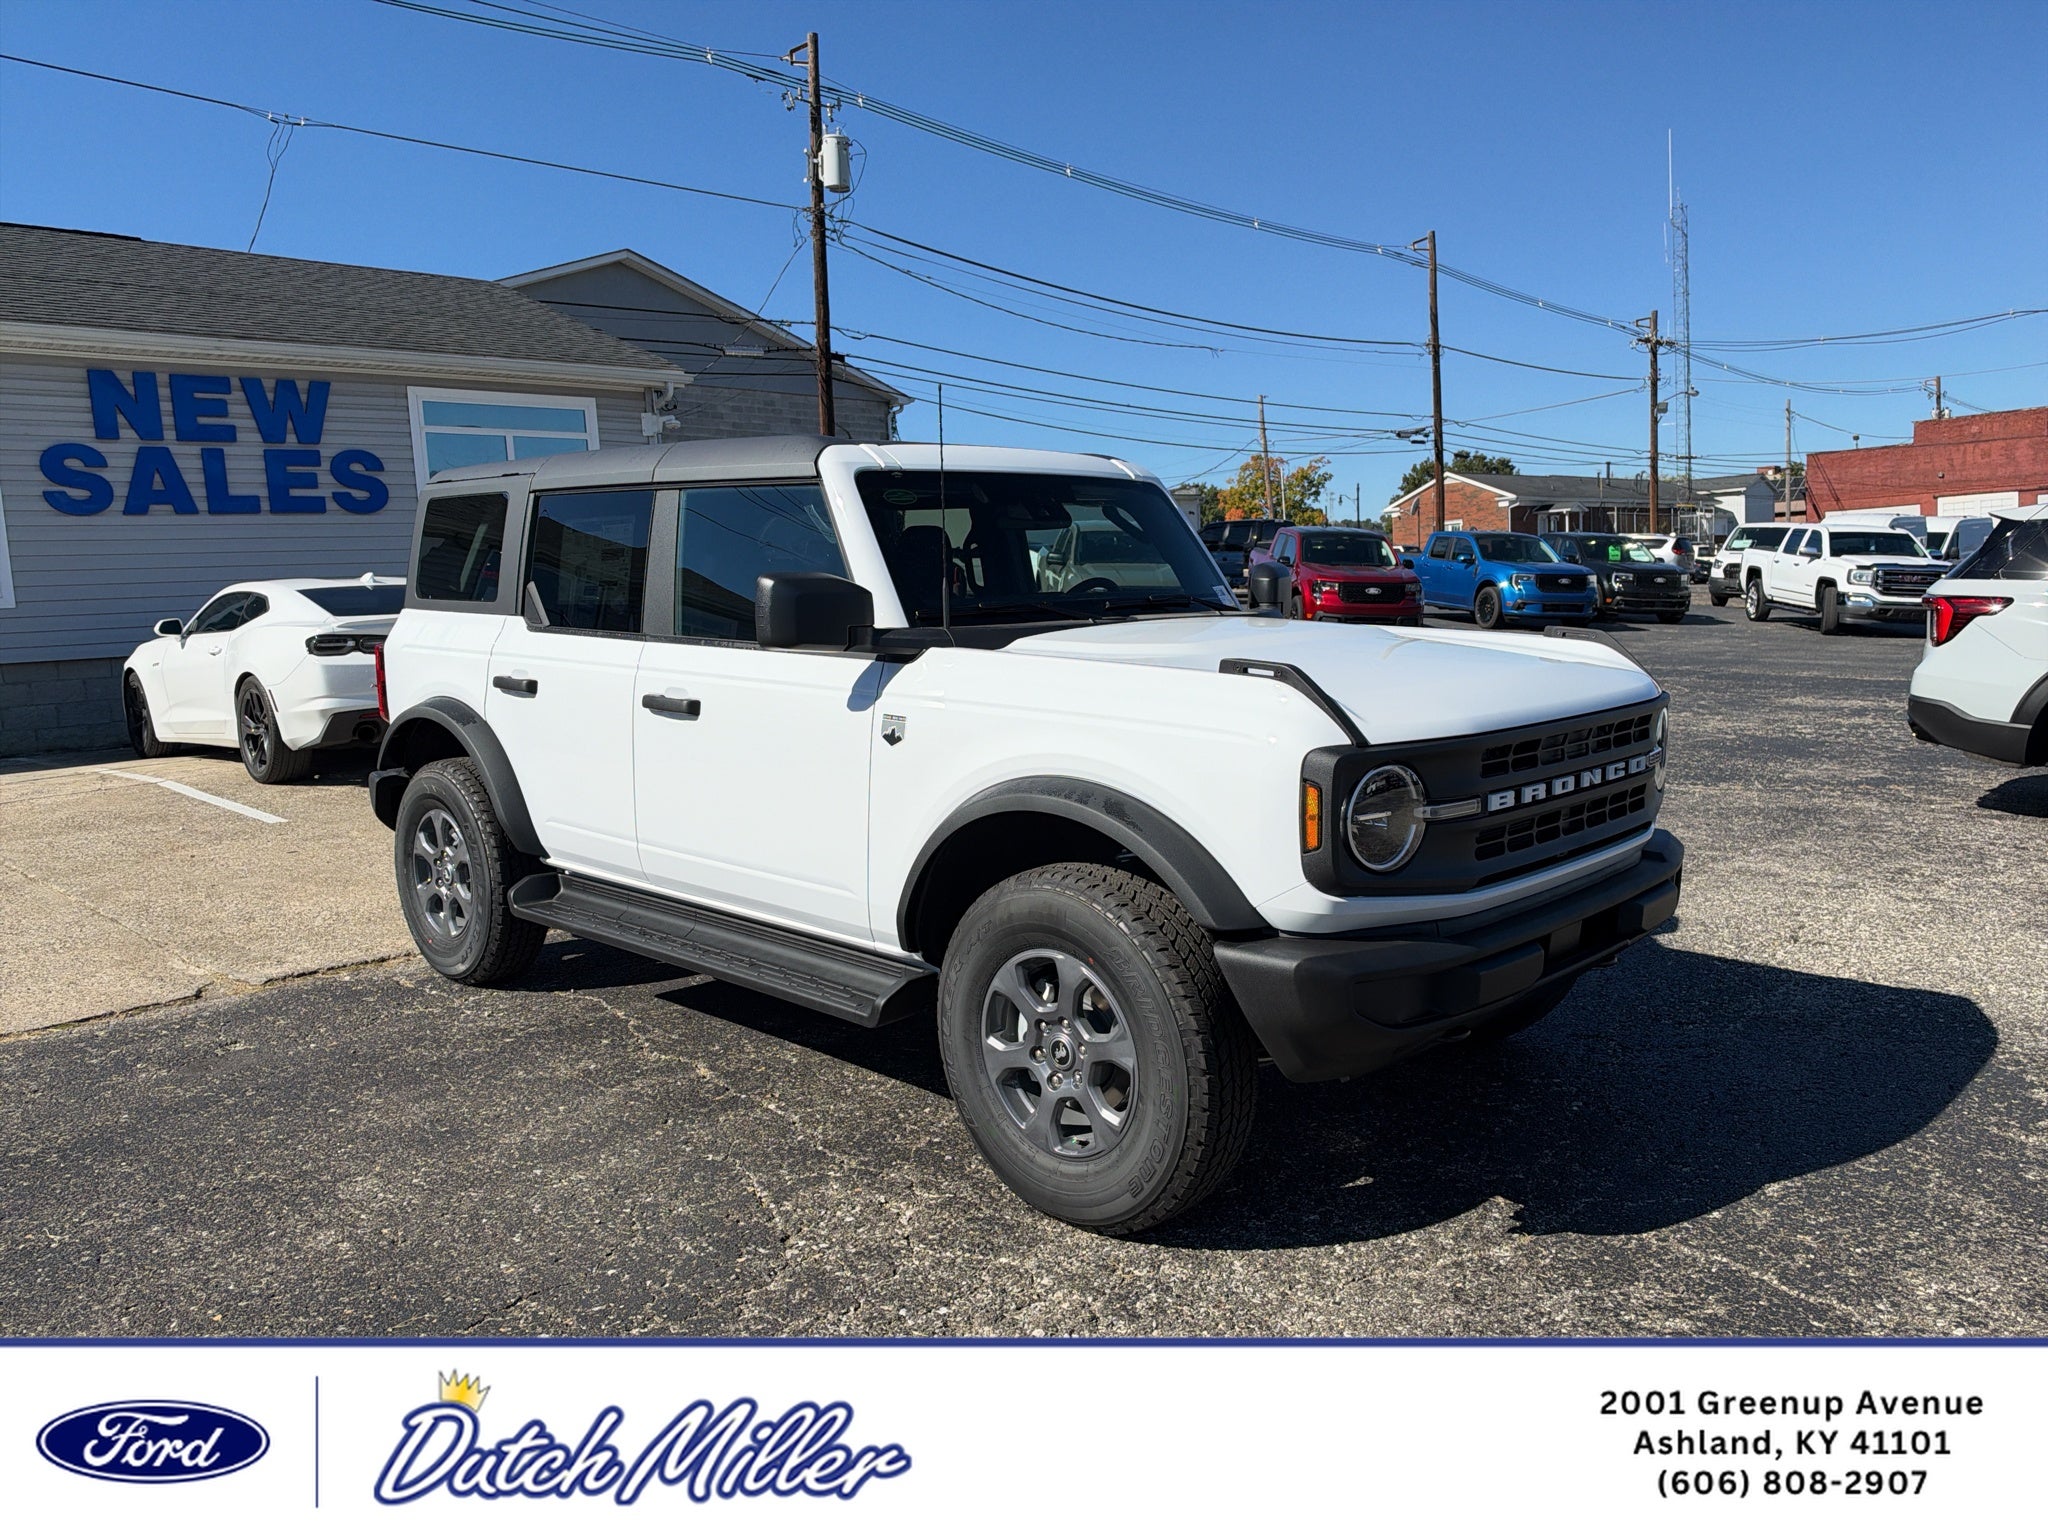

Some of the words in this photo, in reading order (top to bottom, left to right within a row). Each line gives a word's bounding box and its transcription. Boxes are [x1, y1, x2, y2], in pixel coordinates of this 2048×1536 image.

[87, 369, 331, 444] NEW
[39, 442, 389, 516] SALES
[1488, 755, 1647, 812] BRONCO
[1104, 946, 1174, 1198] BRIDGESTONE
